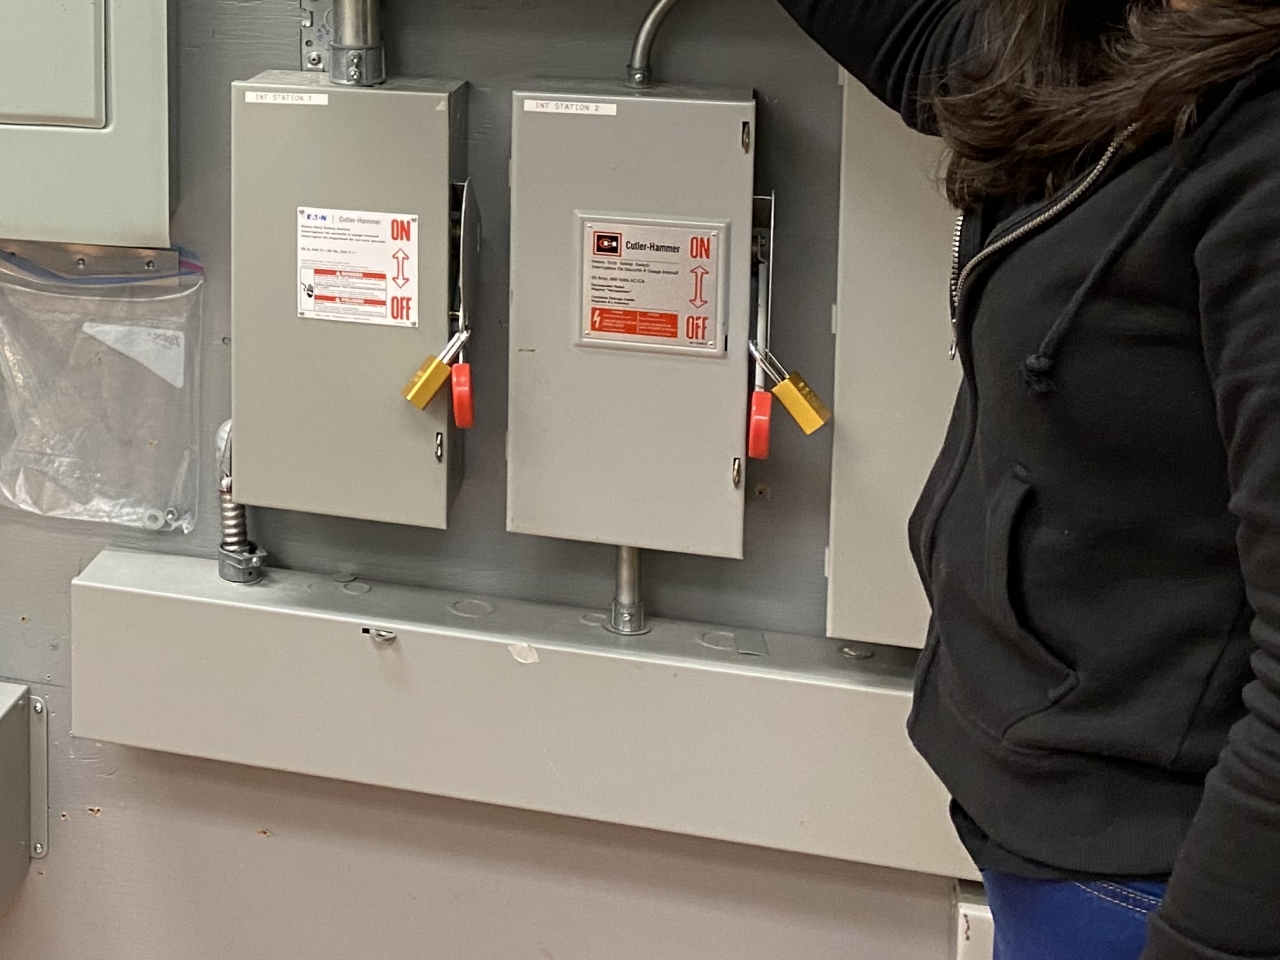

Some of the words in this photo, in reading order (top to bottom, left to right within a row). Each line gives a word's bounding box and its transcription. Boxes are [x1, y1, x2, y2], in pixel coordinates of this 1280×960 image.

[338, 216, 381, 225] Cutler-Hammer
[391, 219, 410, 241] ON
[625, 240, 681, 253] Cutler-Hammer
[690, 237, 710, 259] ON
[391, 296, 411, 320] OFF
[686, 316, 708, 339] OFF
